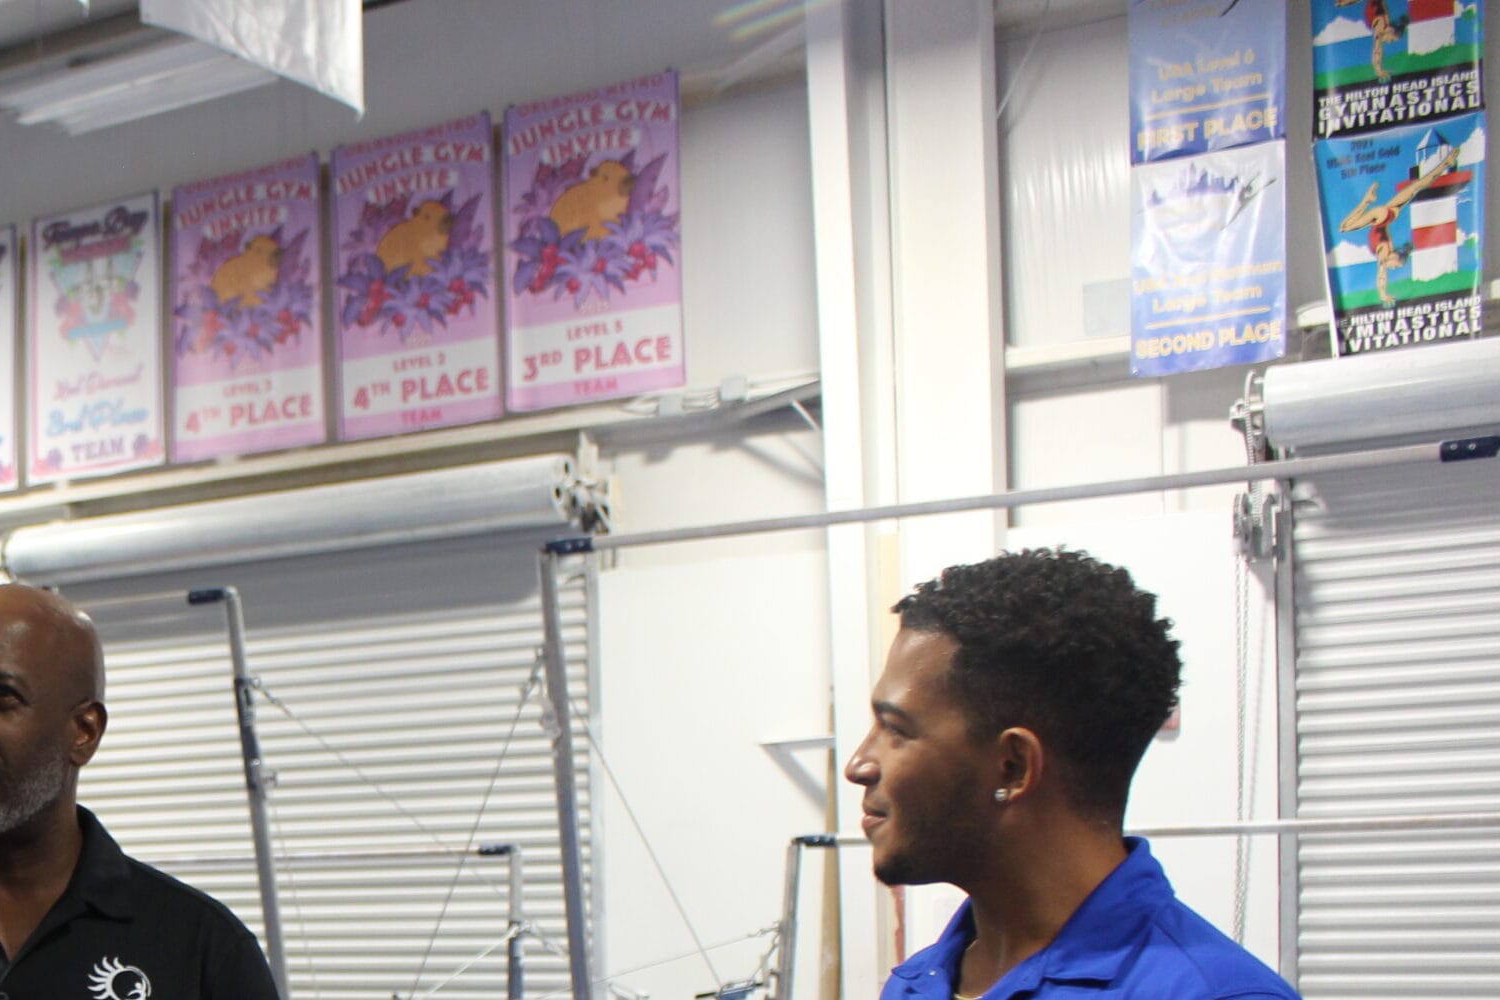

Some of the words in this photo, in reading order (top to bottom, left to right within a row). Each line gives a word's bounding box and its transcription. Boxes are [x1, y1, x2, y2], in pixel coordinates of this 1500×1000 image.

[1151, 83, 1207, 105] Large
[1211, 72, 1264, 94] Team
[1318, 80, 1481, 122] GYMNASTICS
[1319, 94, 1342, 107] THE
[1344, 84, 1390, 103] HILTON
[1392, 79, 1429, 95] HEAD
[1430, 70, 1479, 87] ISLAND
[511, 103, 605, 157] JUNGLE
[615, 99, 672, 123] GYM
[1137, 121, 1200, 152] FIRST
[1203, 105, 1279, 140] PLACE
[1318, 95, 1481, 135] INVITATIONAL
[548, 127, 632, 165] INVITE
[338, 145, 424, 194] JUNGLE
[432, 141, 486, 165] GYM
[372, 168, 450, 203] INVITE
[178, 184, 255, 230] JUNGLE
[265, 179, 312, 201] GYM
[209, 205, 279, 237] INVITE
[1151, 293, 1208, 314] Large
[1211, 285, 1263, 305] Team
[1350, 309, 1394, 327] HILTON
[1396, 303, 1432, 318] HEAD
[1434, 294, 1482, 312] ISLAND
[566, 322, 608, 341] LEVEL
[1135, 331, 1216, 360] SECOND
[1218, 319, 1283, 349] PLACE
[1340, 305, 1483, 341] YMNASTICS
[392, 355, 434, 373] LEVEL
[522, 350, 563, 382] 3RD
[573, 335, 672, 374] PLACE
[353, 379, 391, 410] 4TH
[401, 366, 489, 403] PLACE
[574, 377, 618, 395] TEAM
[229, 392, 313, 428] PLACE
[401, 407, 443, 425] TEAM
[70, 437, 125, 462] TEAM
